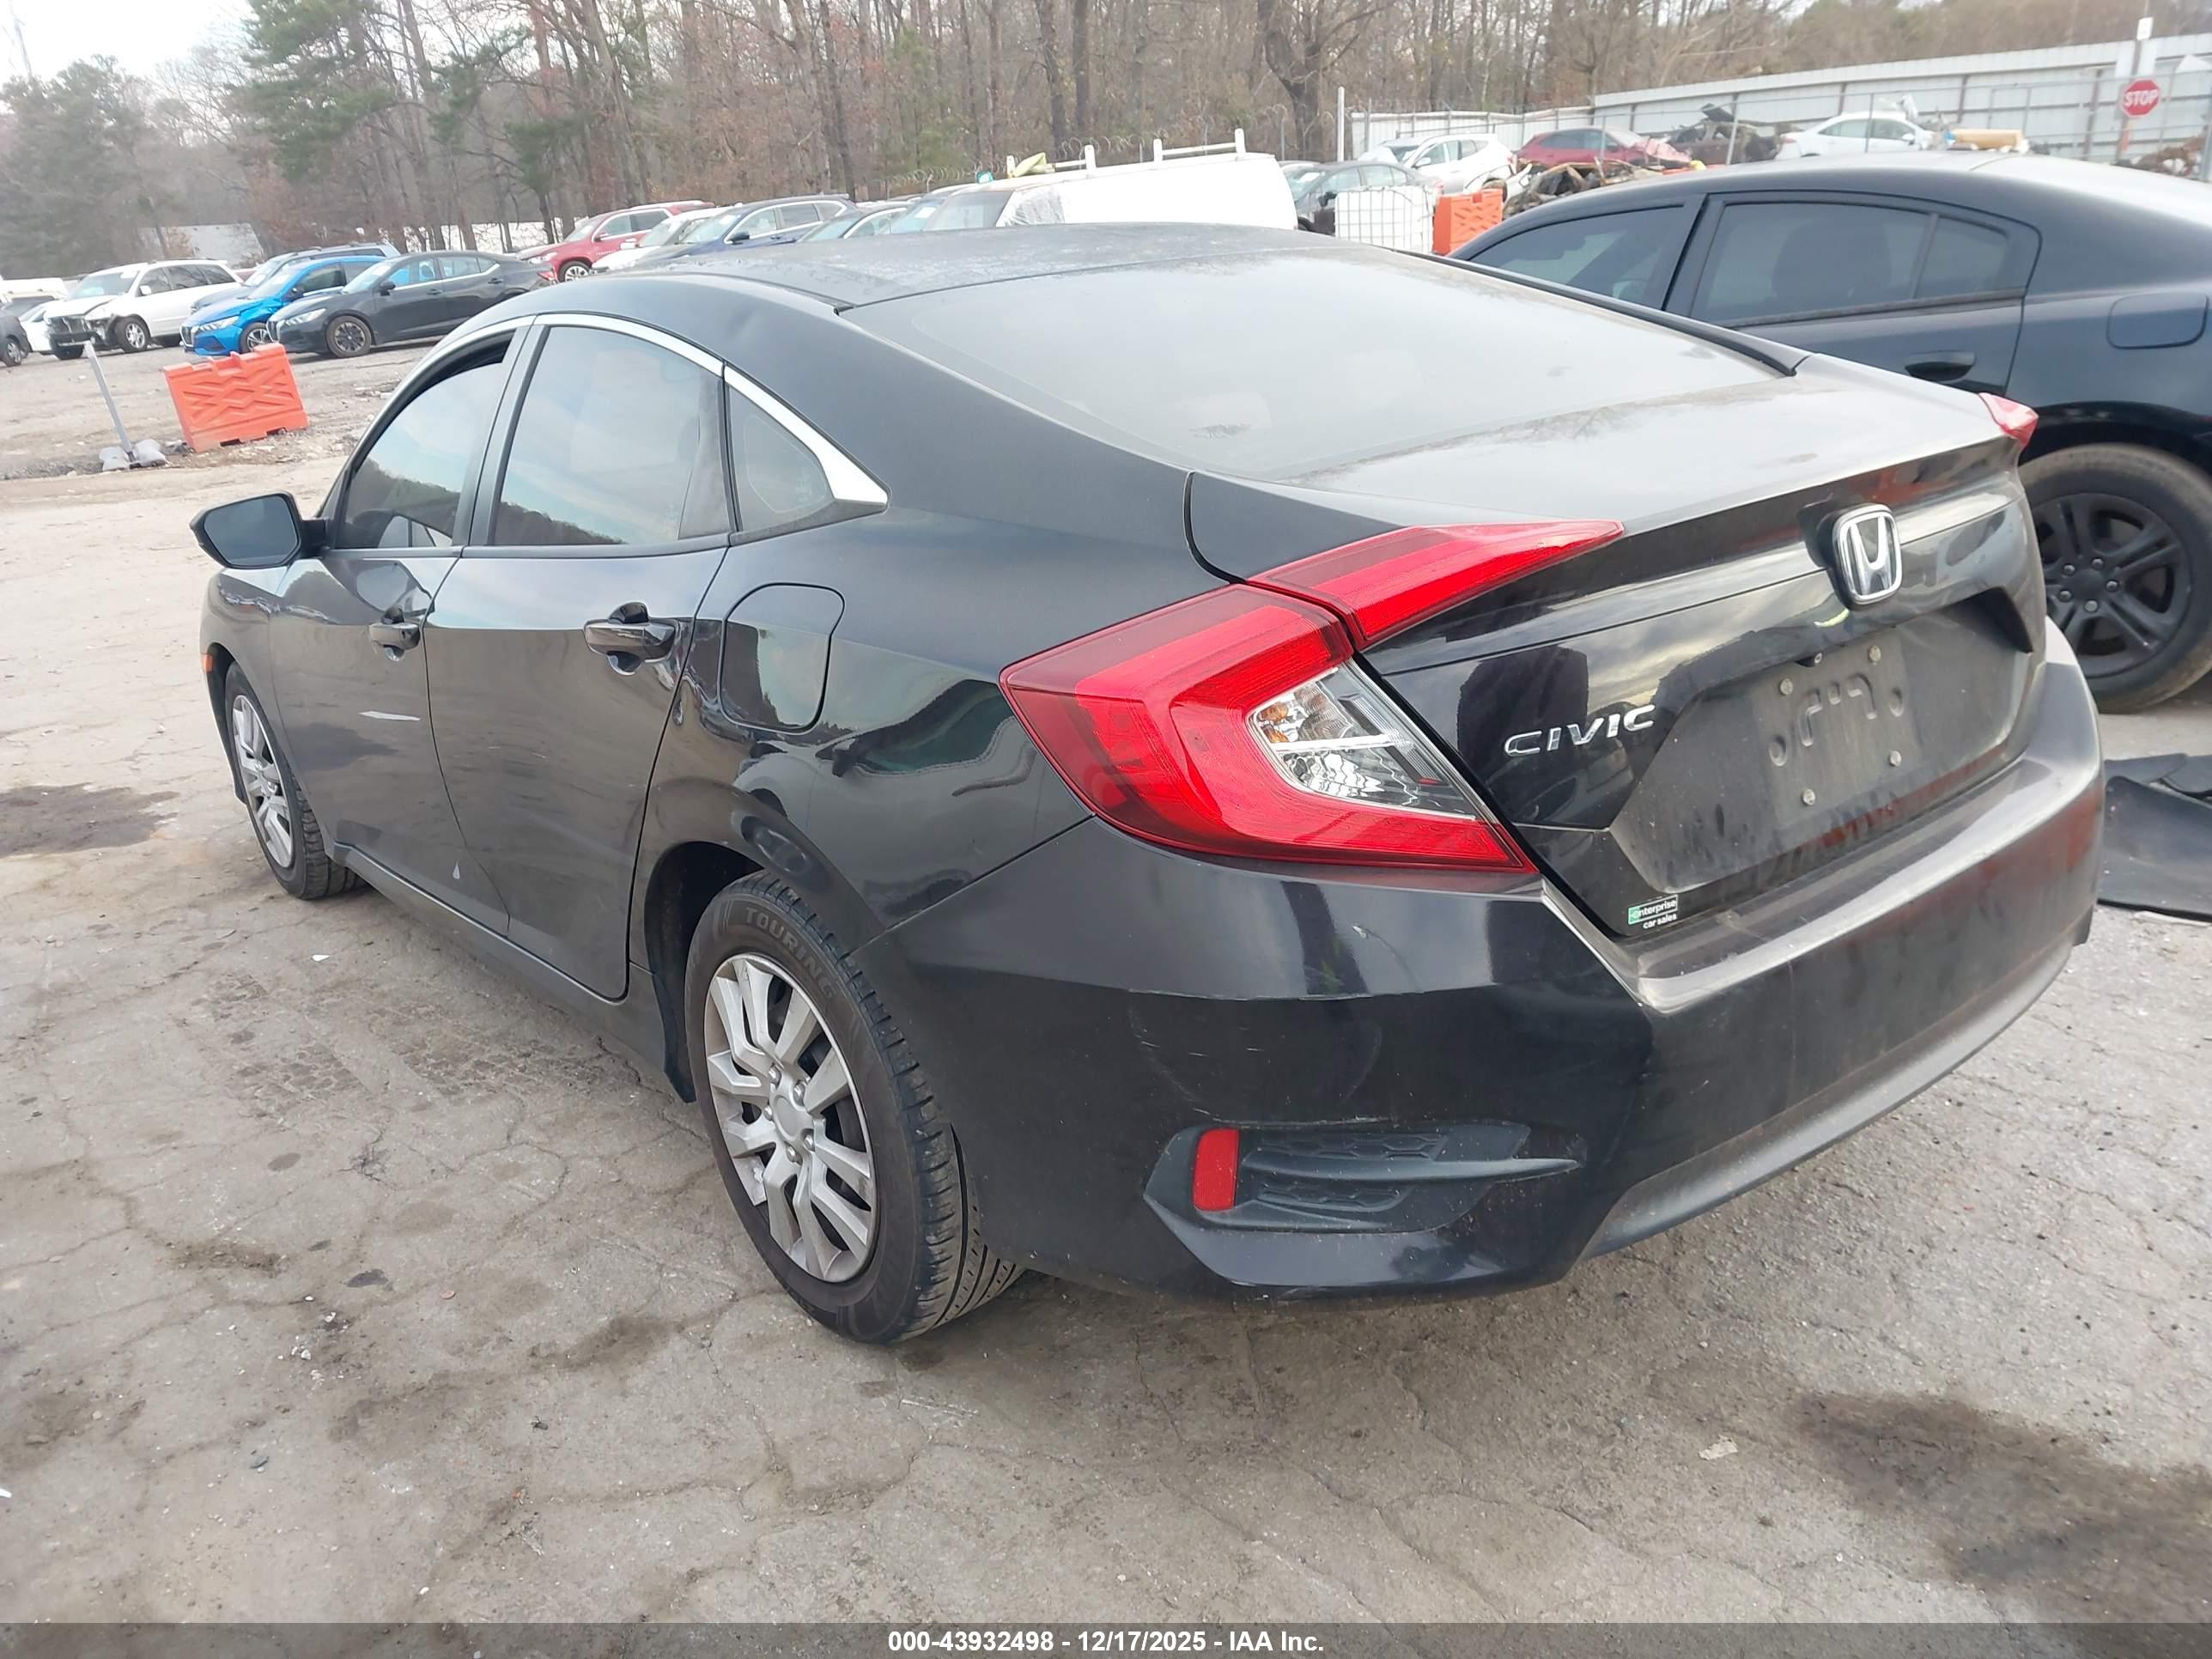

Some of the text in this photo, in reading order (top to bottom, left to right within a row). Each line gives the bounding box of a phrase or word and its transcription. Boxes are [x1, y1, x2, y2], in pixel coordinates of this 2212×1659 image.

[2124, 89, 2158, 107] STOP
[1504, 703, 1656, 757] CIVIC
[1630, 899, 1677, 919] enterprise
[1643, 913, 1677, 929] car sales
[744, 907, 833, 999] TOURING
